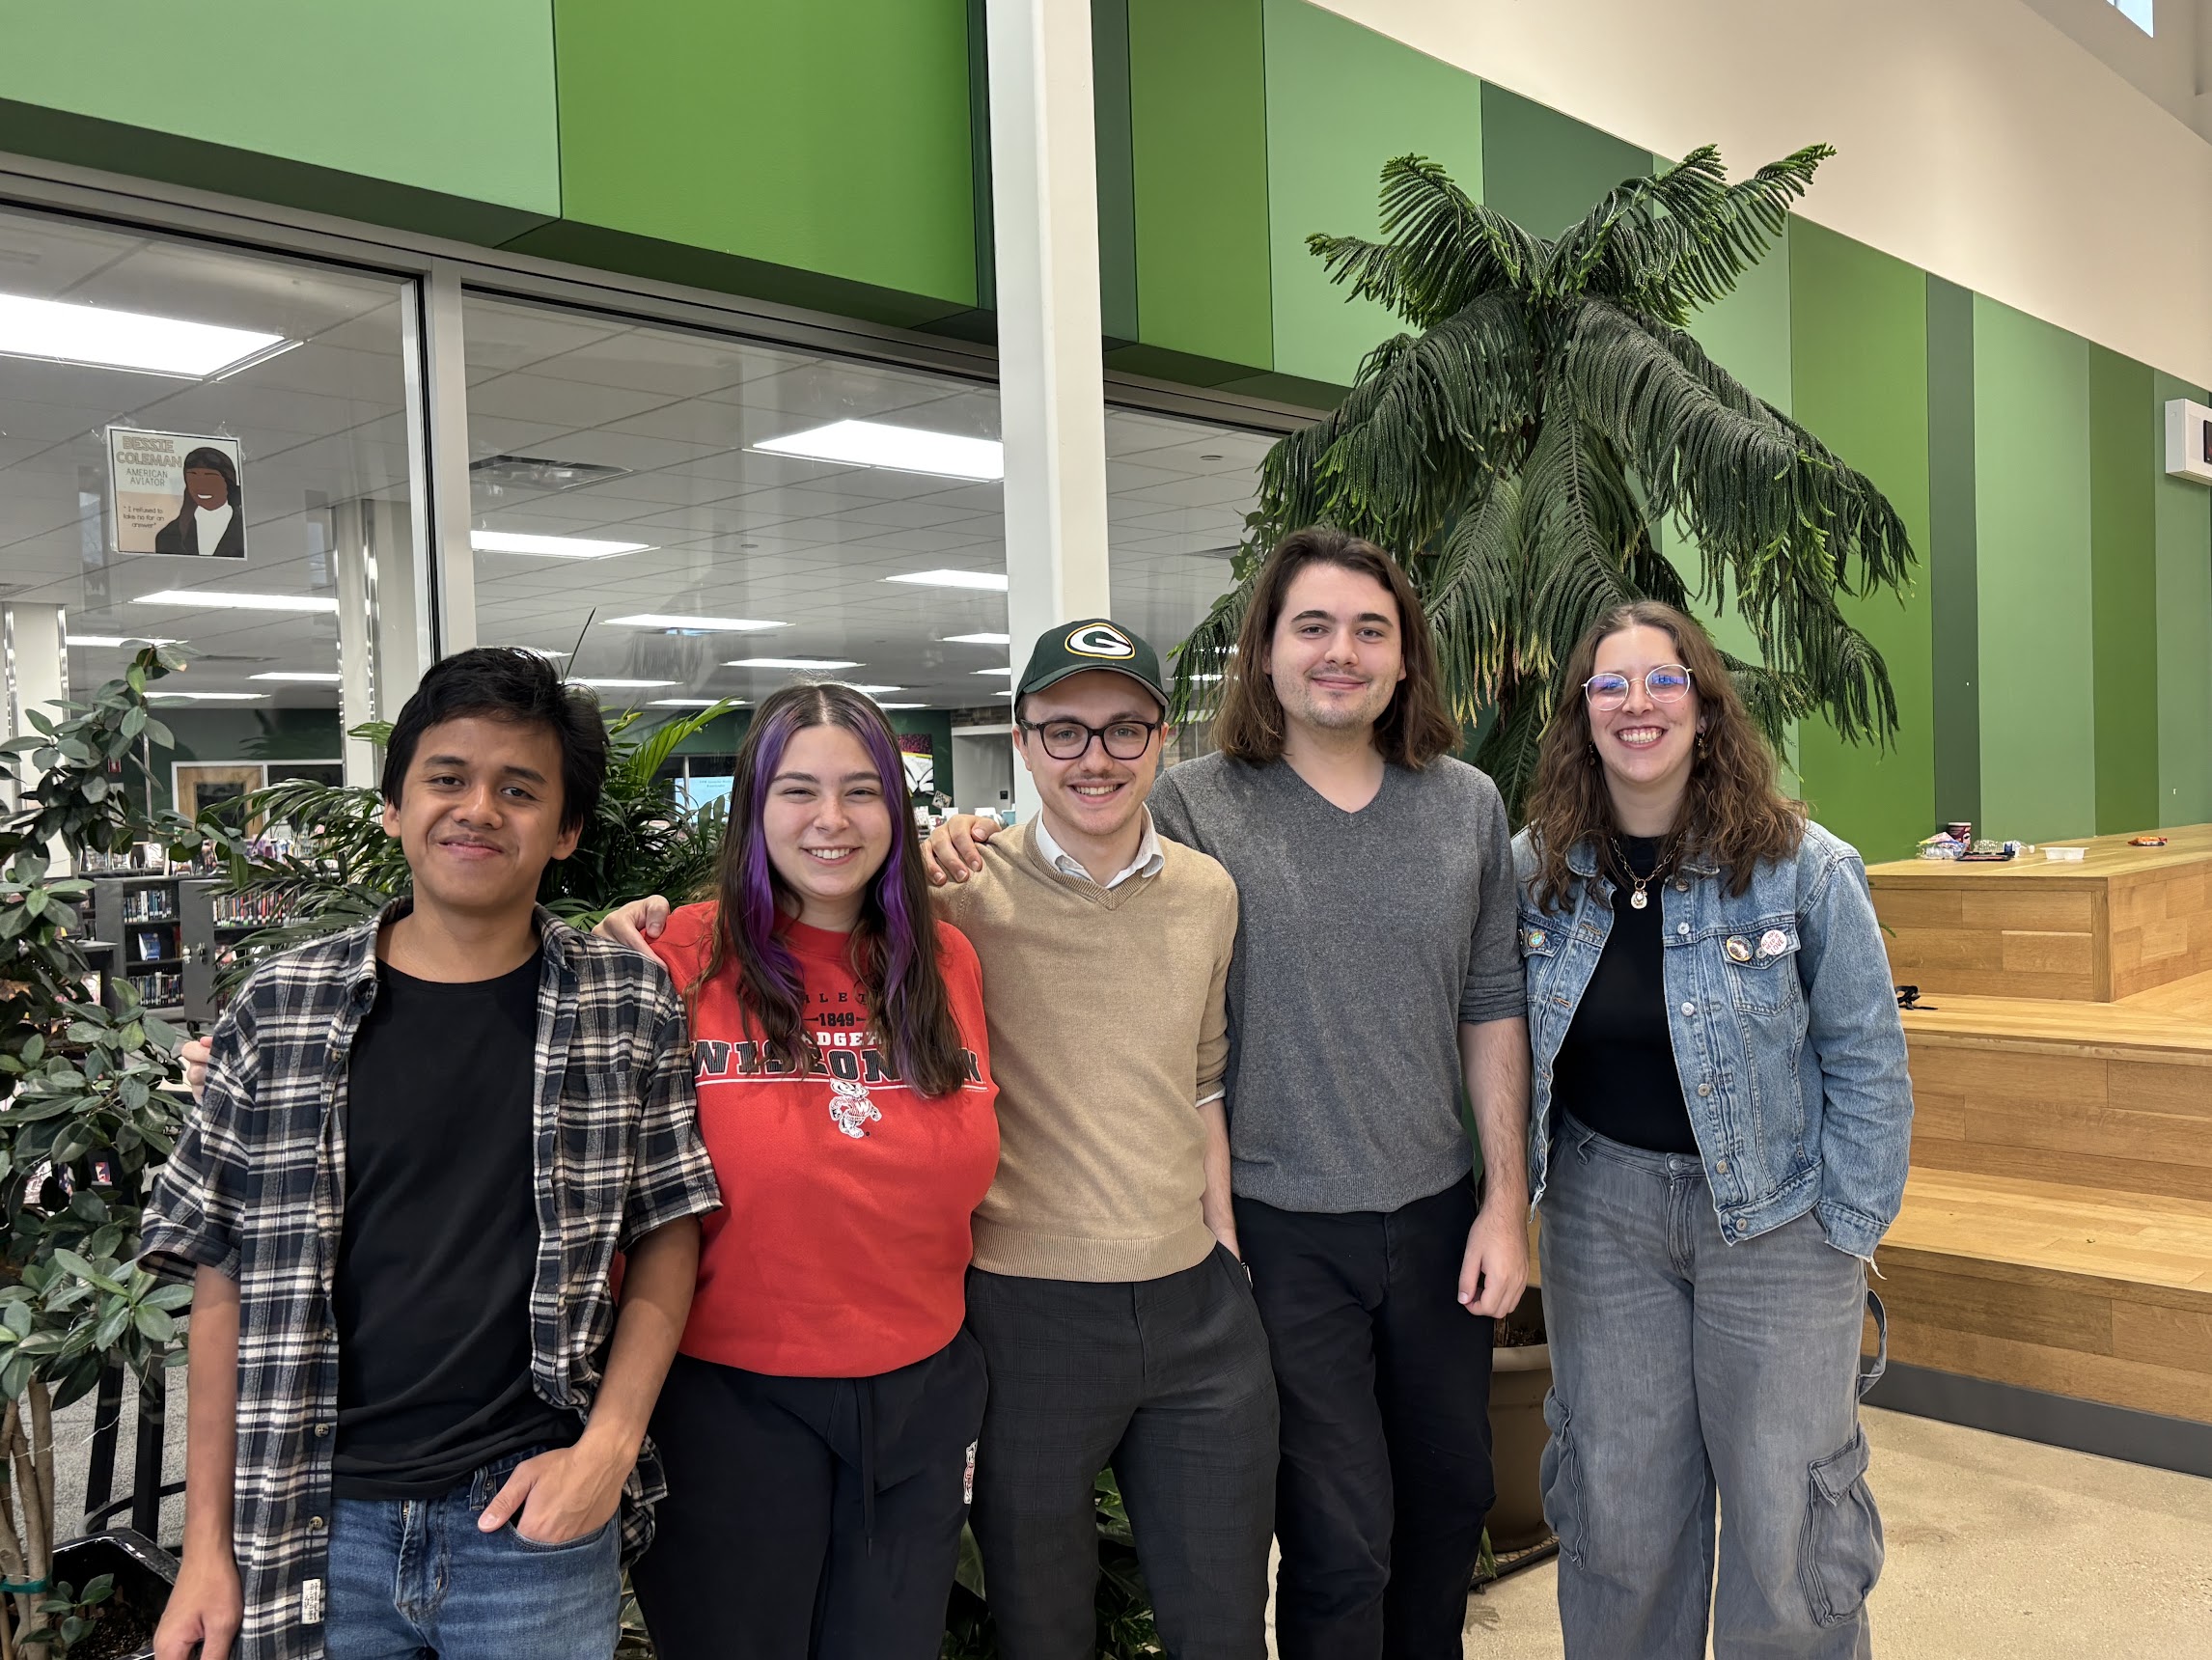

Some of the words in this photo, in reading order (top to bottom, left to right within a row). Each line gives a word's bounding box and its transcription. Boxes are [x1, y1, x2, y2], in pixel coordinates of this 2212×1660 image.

[123, 436, 174, 453] BESSIE
[116, 452, 181, 468] COLEMAN
[126, 468, 168, 478] AMERICAN
[130, 477, 165, 486] AVIATOR
[1066, 623, 1134, 658] G
[1771, 937, 1784, 954] LOVE
[818, 1011, 855, 1028] 1849
